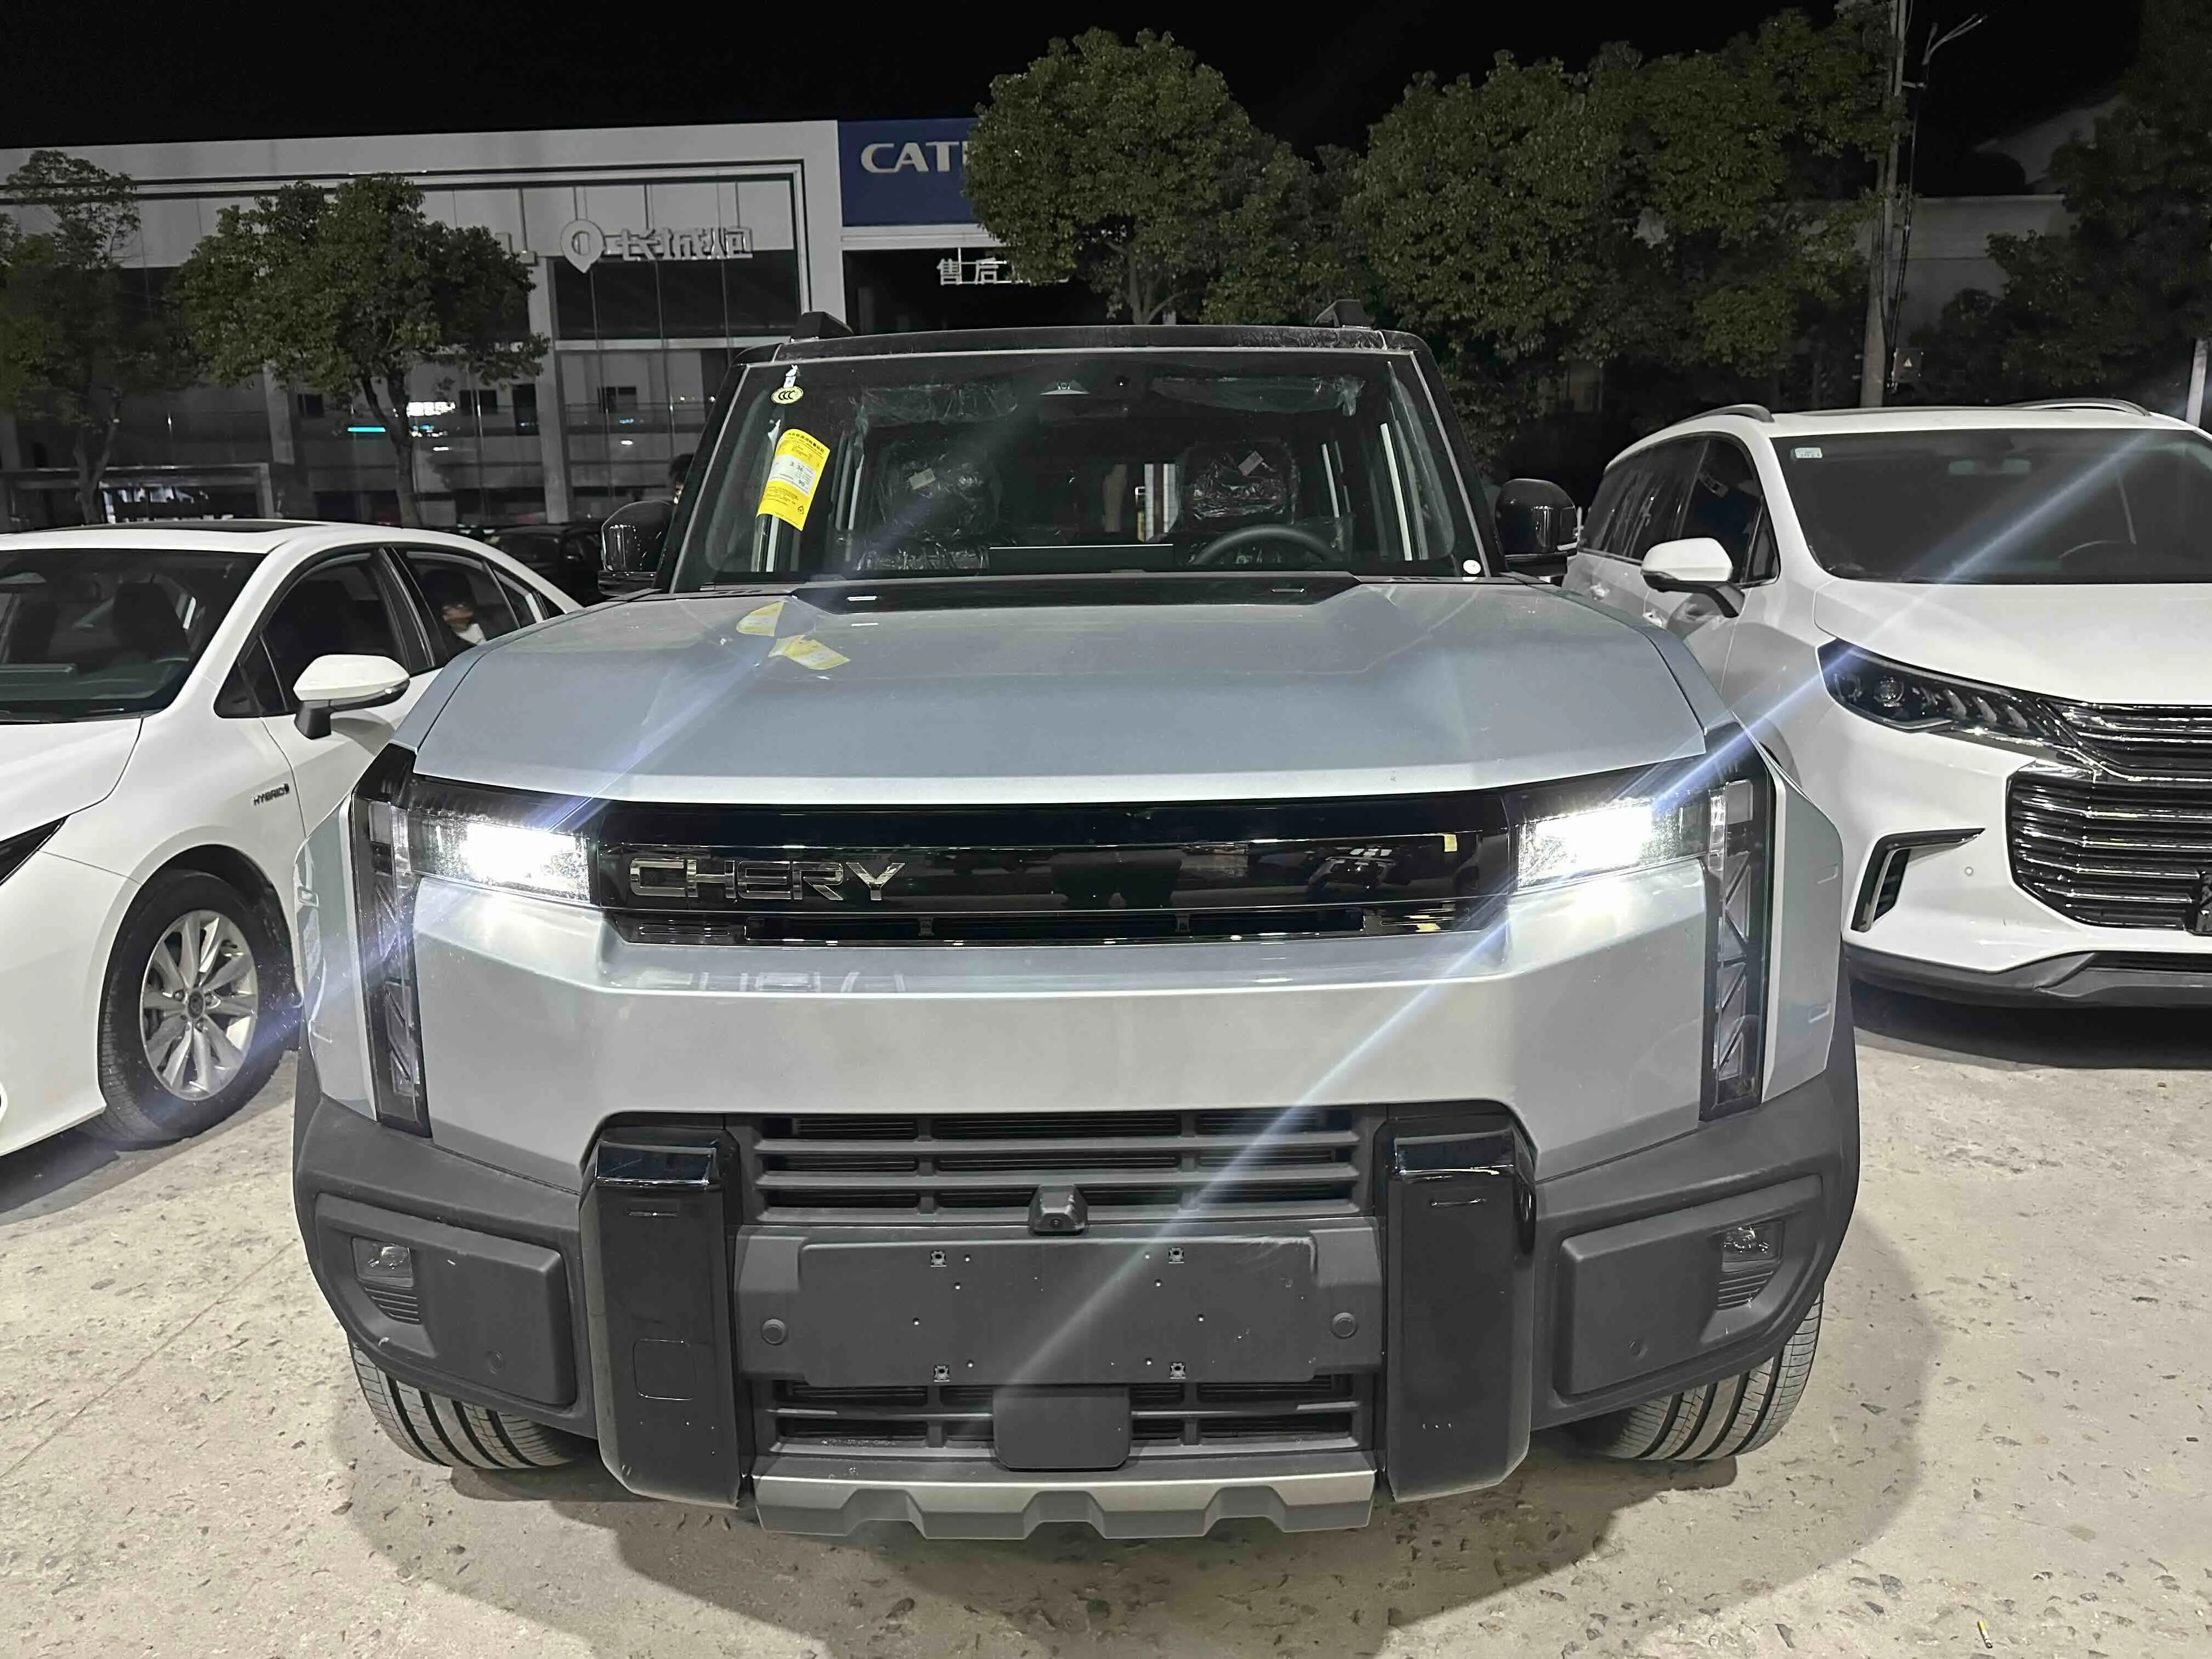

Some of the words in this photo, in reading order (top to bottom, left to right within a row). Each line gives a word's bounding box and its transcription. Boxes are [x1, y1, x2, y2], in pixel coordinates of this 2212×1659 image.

[860, 141, 968, 173] CAT
[253, 787, 285, 806] HYBRID
[629, 857, 906, 901] CHERY
